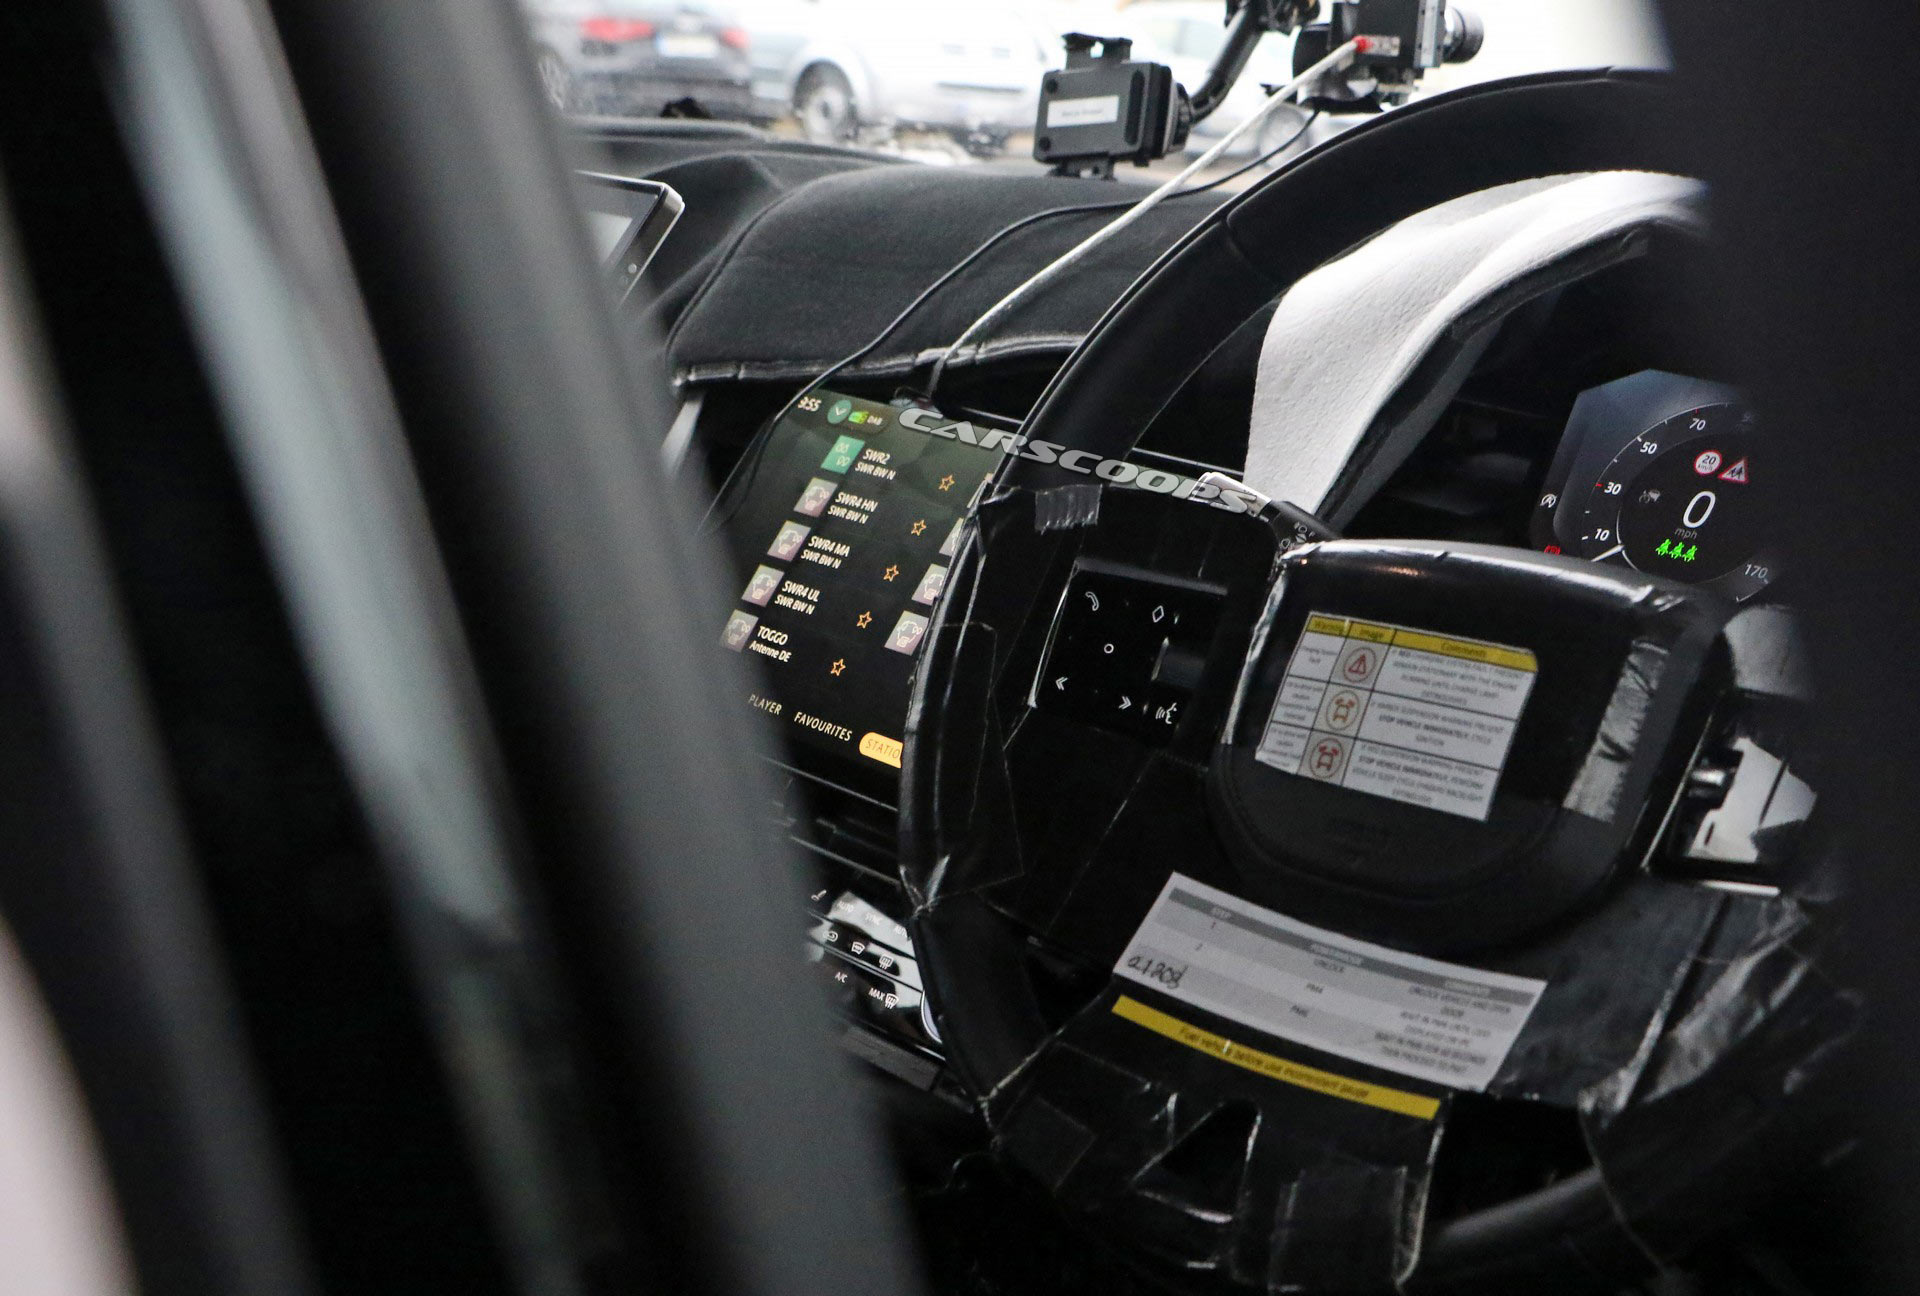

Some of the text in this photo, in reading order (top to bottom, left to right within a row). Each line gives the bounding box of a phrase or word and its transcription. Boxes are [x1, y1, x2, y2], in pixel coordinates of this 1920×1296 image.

[1689, 418, 1706, 431] 70
[863, 449, 891, 465] SWR2
[1640, 442, 1657, 454] 50
[1702, 455, 1717, 465] 20
[855, 462, 896, 480] SWR BW N
[1604, 482, 1622, 495] 30
[835, 492, 878, 513] SWR4 HN
[1683, 491, 1716, 528] 0
[828, 504, 869, 525] SWR BW N
[1594, 528, 1610, 542] 10
[1674, 527, 1698, 540] mph
[808, 535, 850, 557] SWR4 MA
[801, 549, 842, 569] SWR BW N
[1744, 563, 1768, 579] 170
[782, 580, 821, 602] SWR4 UL
[774, 594, 815, 616] SWR BW N
[757, 625, 789, 646] TOGGO
[749, 640, 792, 663] Antenne DE
[749, 694, 782, 715] PLAYER
[794, 711, 852, 742] FAVOURITES
[869, 987, 885, 1001] MAX
